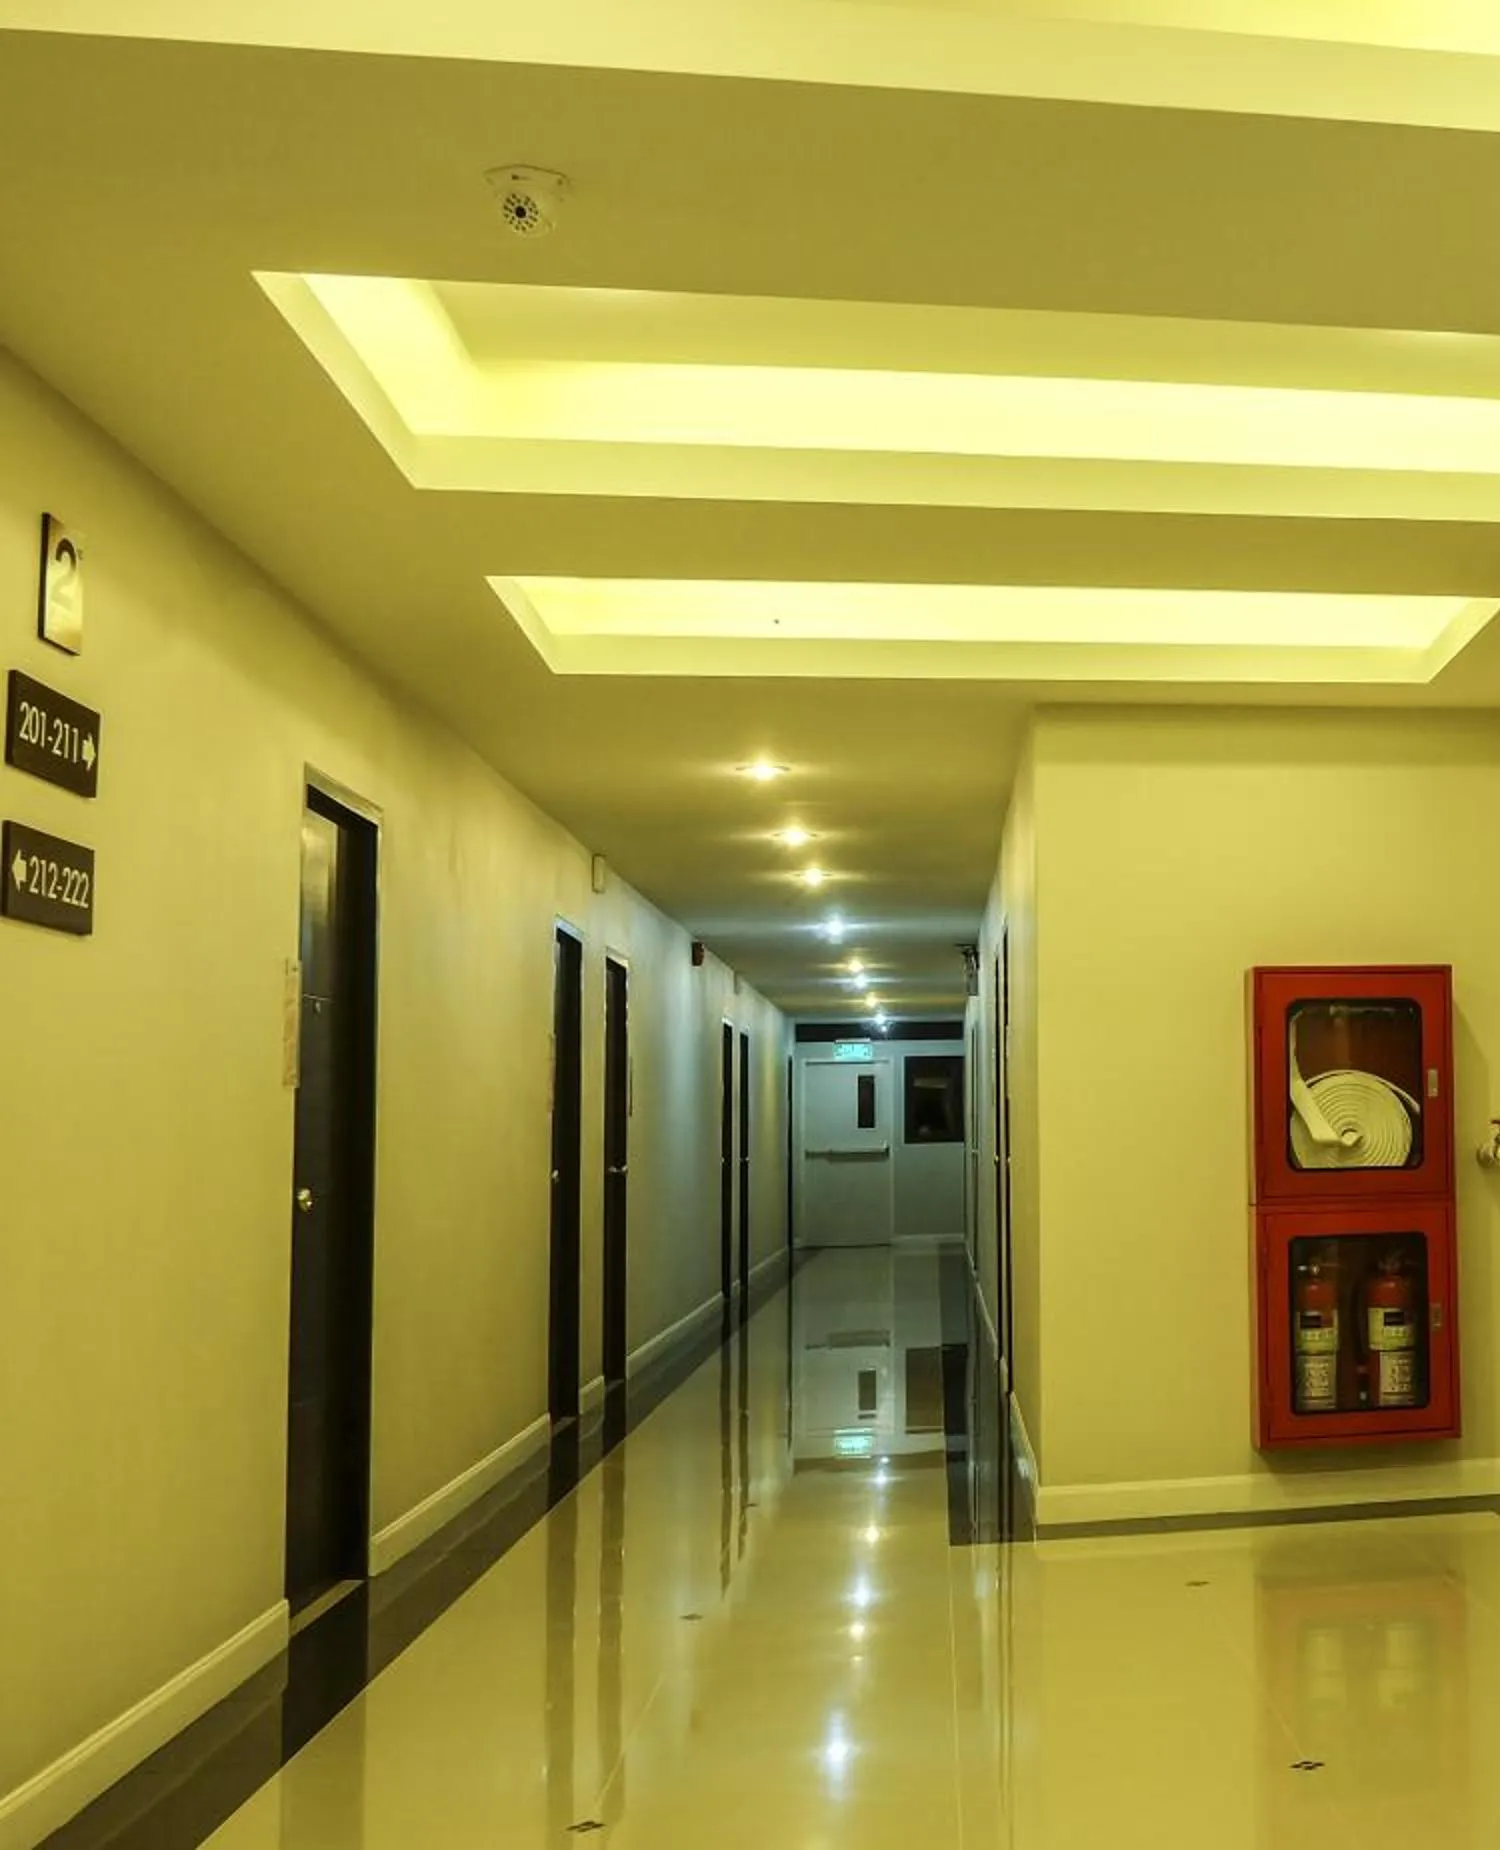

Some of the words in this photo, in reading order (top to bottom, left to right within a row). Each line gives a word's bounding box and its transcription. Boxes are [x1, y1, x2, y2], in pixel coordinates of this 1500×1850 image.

[51, 538, 77, 613] 2
[19, 701, 79, 763] 201-211
[29, 855, 89, 909] 212-222
